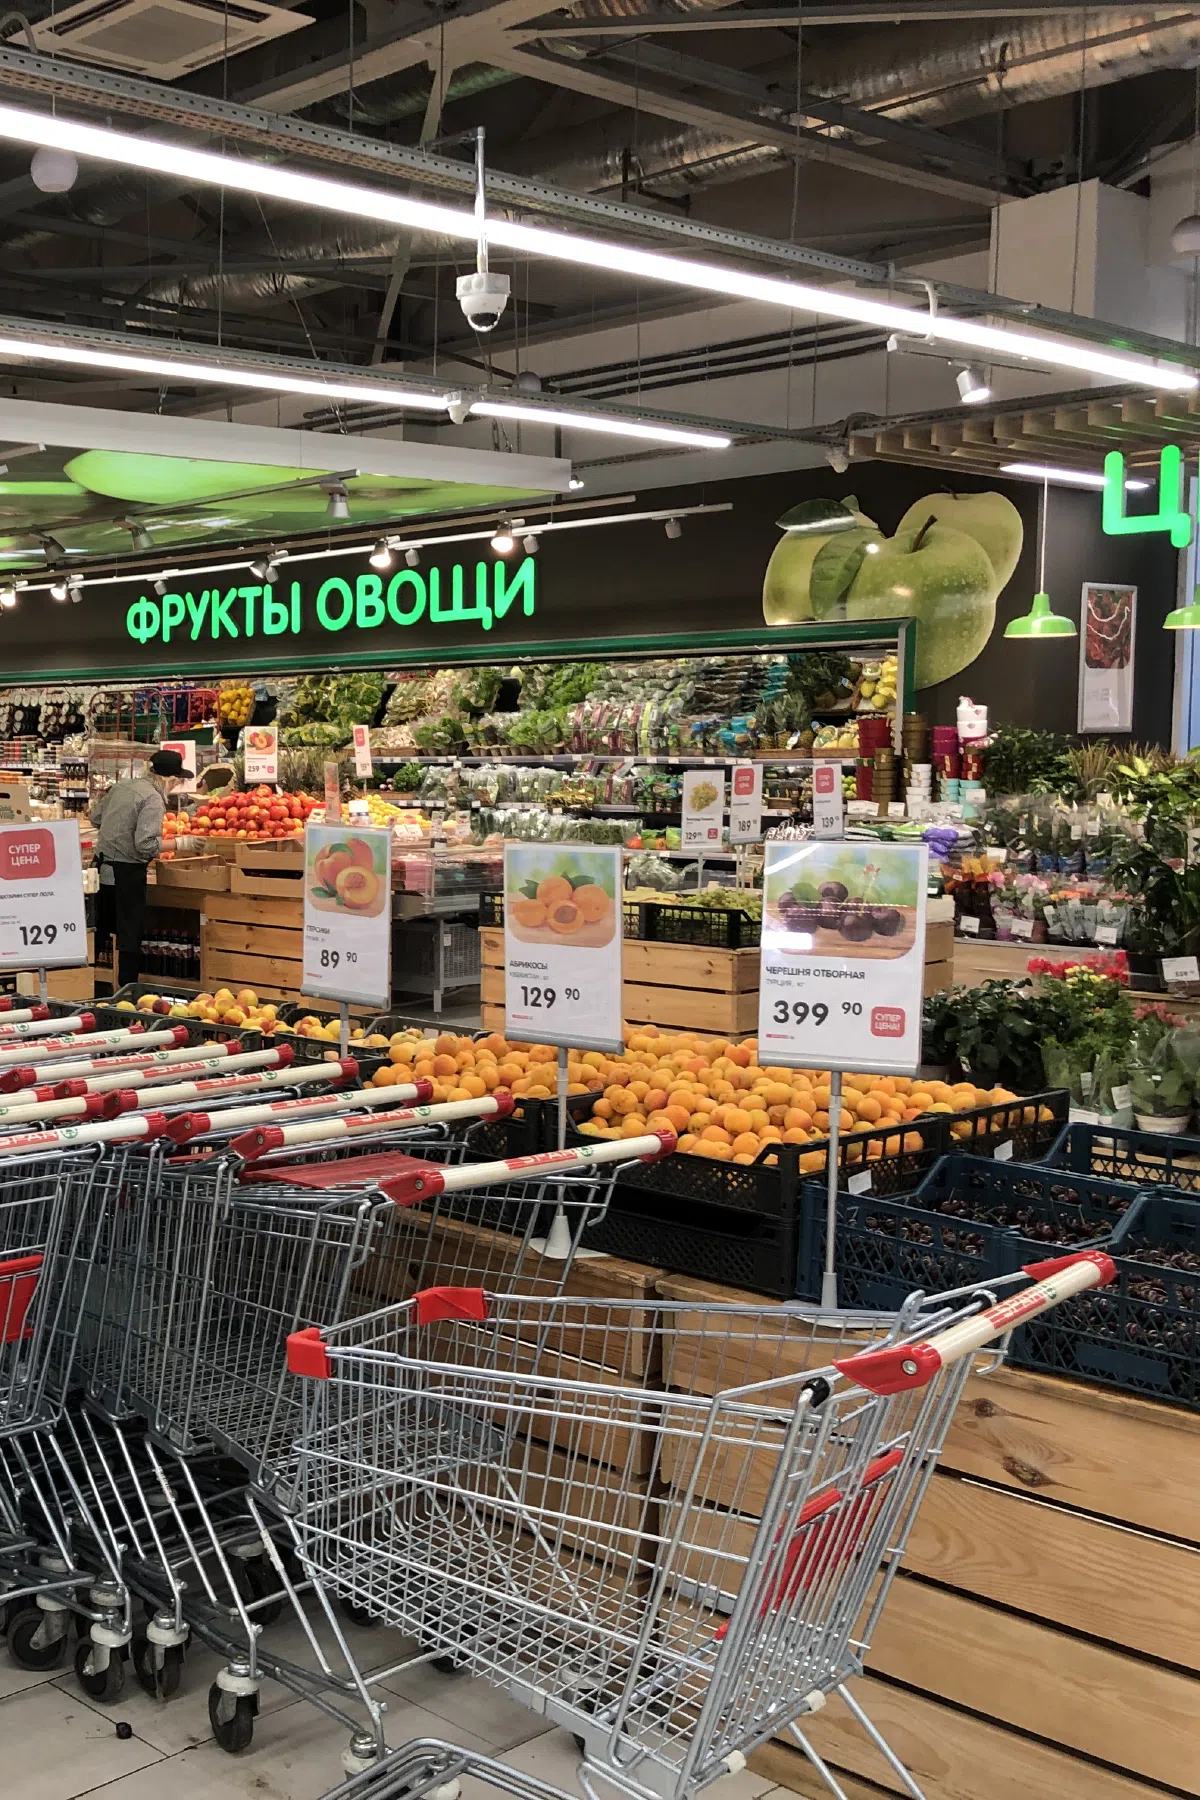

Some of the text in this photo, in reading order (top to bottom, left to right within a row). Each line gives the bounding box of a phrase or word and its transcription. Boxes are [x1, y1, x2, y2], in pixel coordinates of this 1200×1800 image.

[1102, 445, 1200, 548] Ц
[126, 557, 535, 644] ФРУКТЫ ОВОЩИ
[738, 820, 751, 832] 189
[822, 817, 834, 828] 139
[9, 843, 41, 854] СУПЕР
[11, 856, 40, 866] ЦЕНА
[19, 923, 76, 946] 129 90
[321, 949, 357, 969] 89 90
[509, 960, 548, 969] АБРИКОСЫ
[766, 966, 865, 979] ЧЕРЕШНЯ ОТБОРНАЯ
[521, 986, 580, 1009] 129 90
[773, 999, 863, 1026] 399 90
[875, 1013, 901, 1022] СУПЕР
[875, 1022, 900, 1031] ЦЕНА!
[523, 1149, 577, 1165] SPAR
